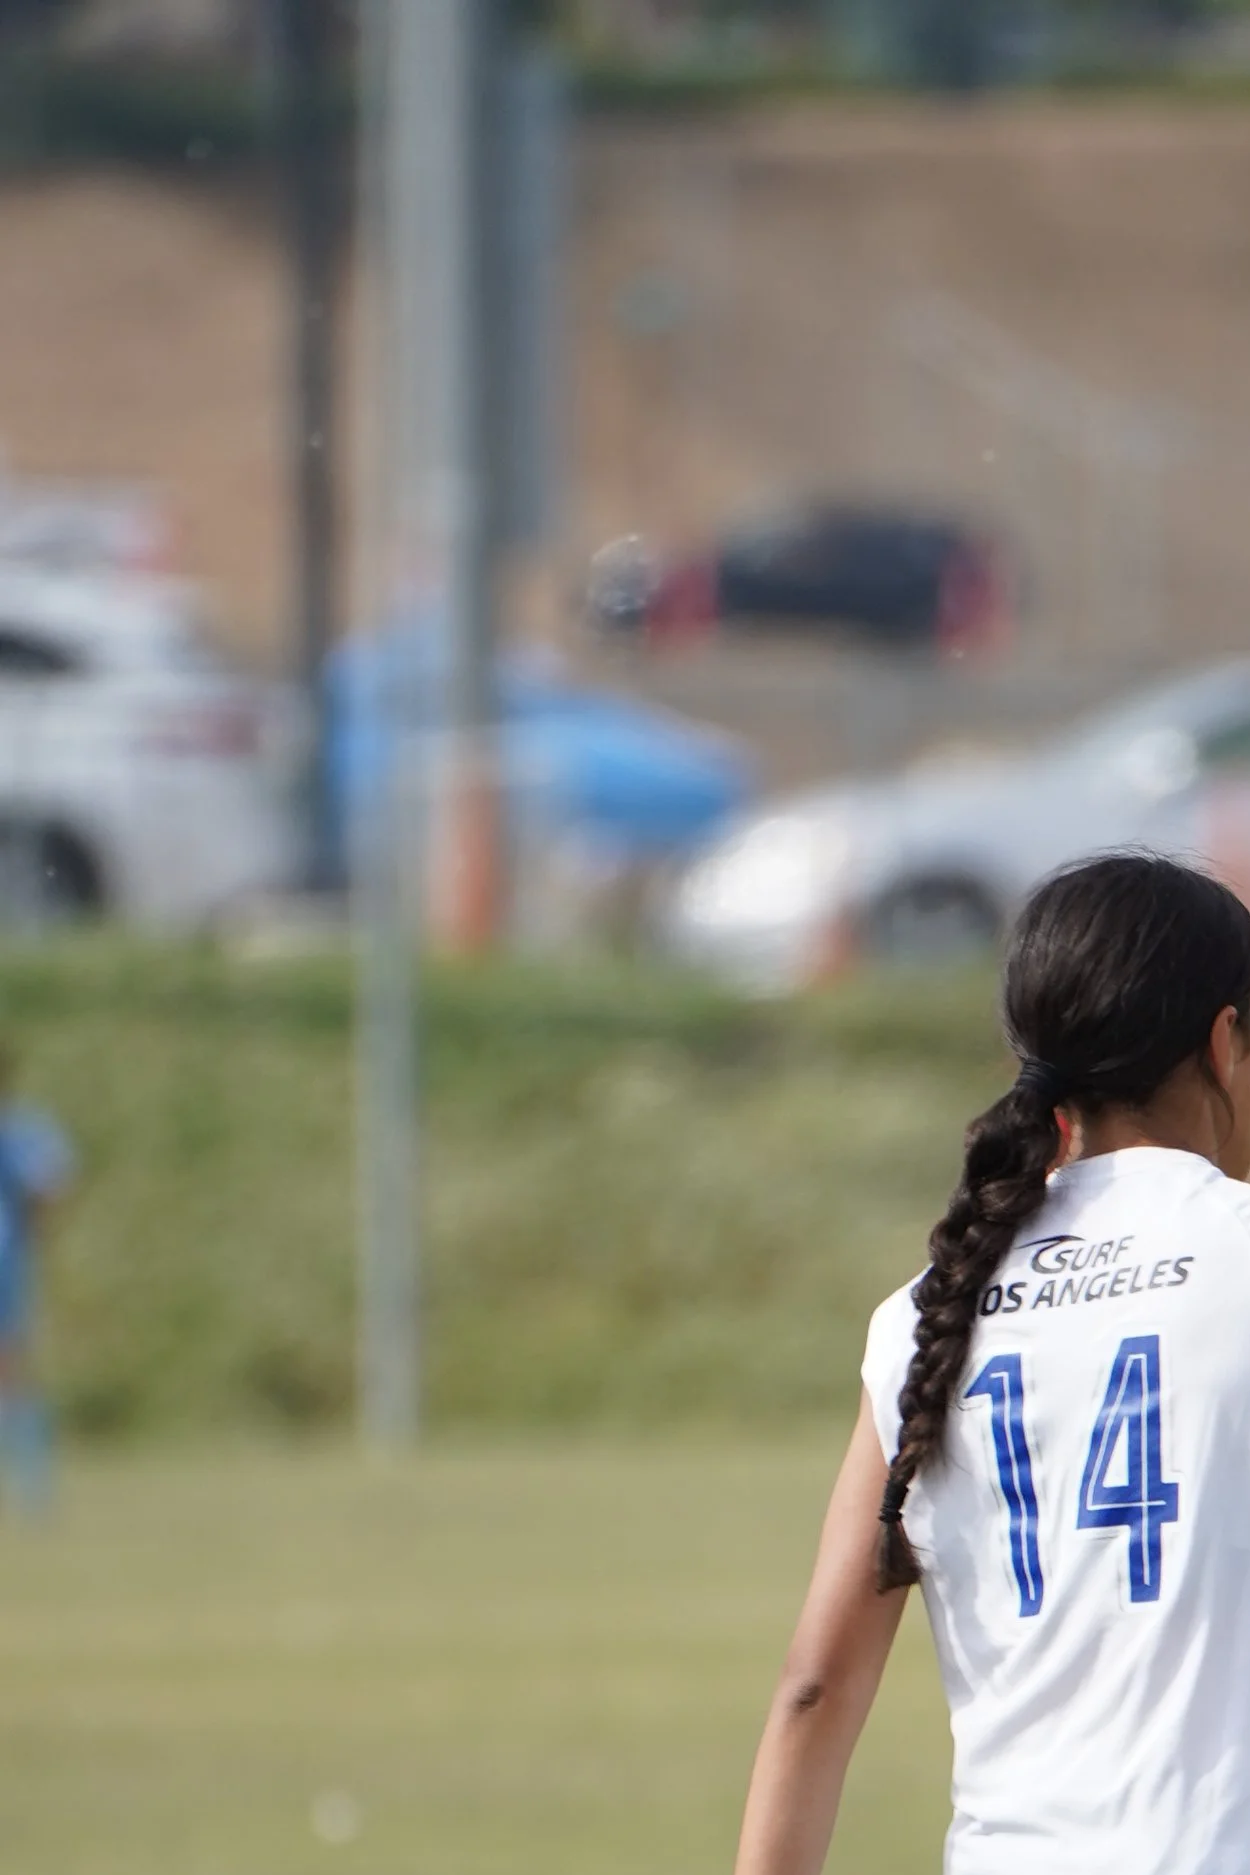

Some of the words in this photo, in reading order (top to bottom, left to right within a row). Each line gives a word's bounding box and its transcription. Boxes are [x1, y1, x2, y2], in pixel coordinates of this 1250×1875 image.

[1051, 1235, 1135, 1273] SURF
[979, 1281, 1028, 1316] OS
[1031, 1256, 1195, 1310] ANGELES
[963, 1333, 1179, 1618] 14
